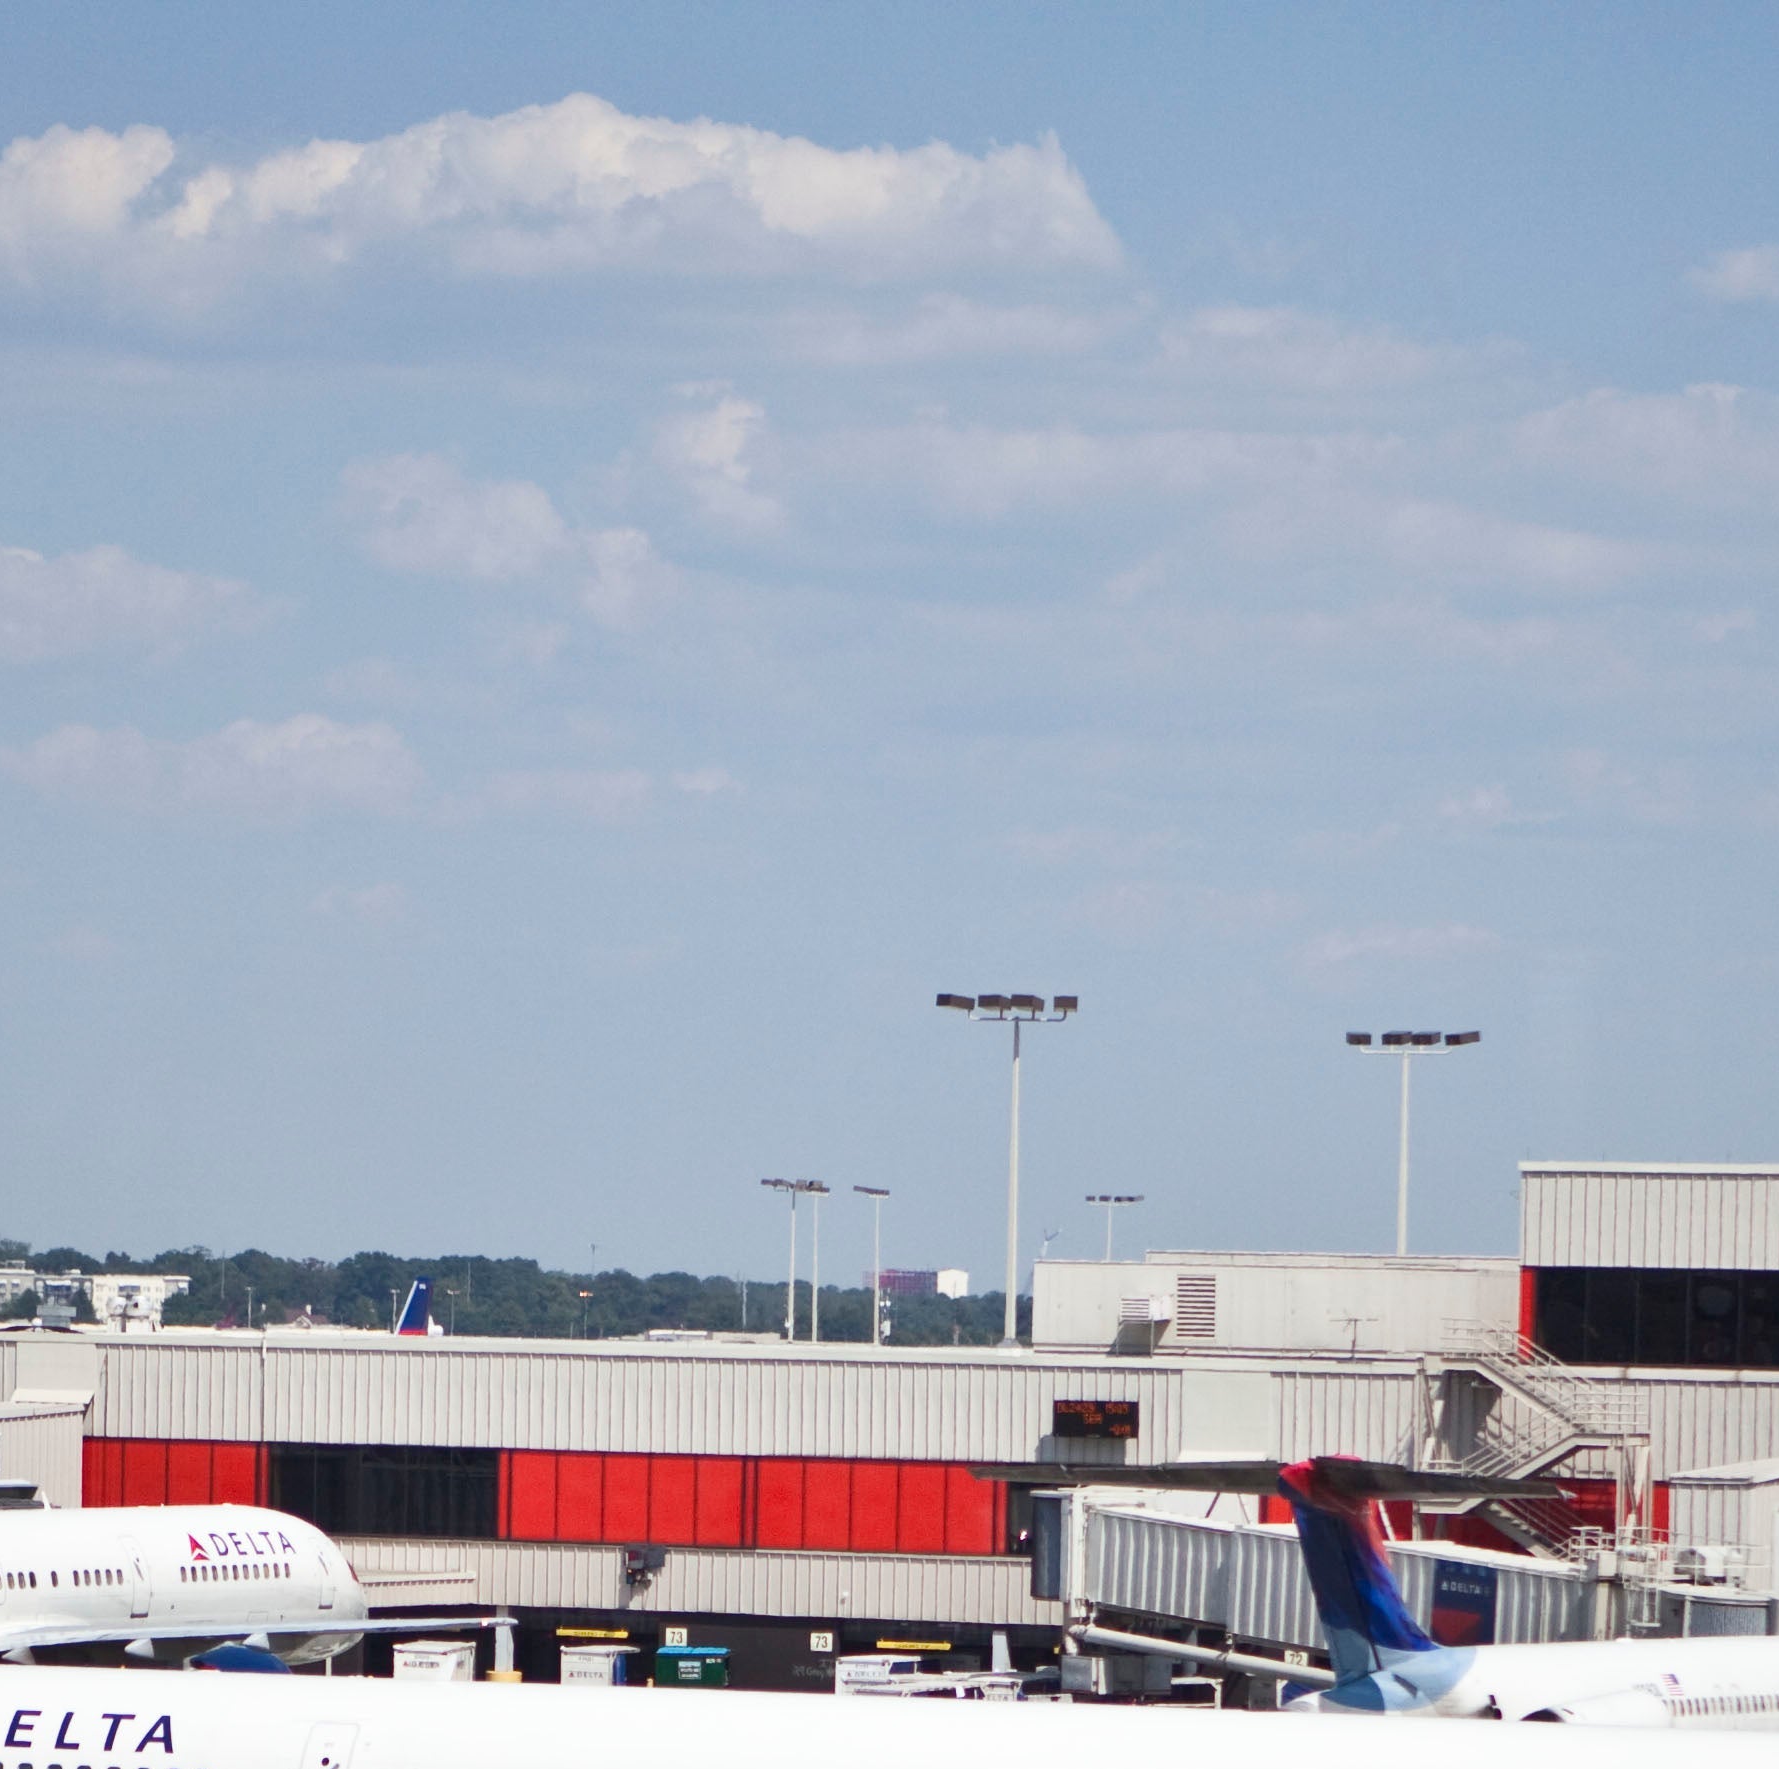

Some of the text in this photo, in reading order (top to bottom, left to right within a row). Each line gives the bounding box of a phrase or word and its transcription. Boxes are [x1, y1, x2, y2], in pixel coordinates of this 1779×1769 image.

[208, 1531, 297, 1556] DELTA
[669, 1631, 683, 1644] 73
[815, 1635, 828, 1649] 73
[1289, 1653, 1303, 1665] 72
